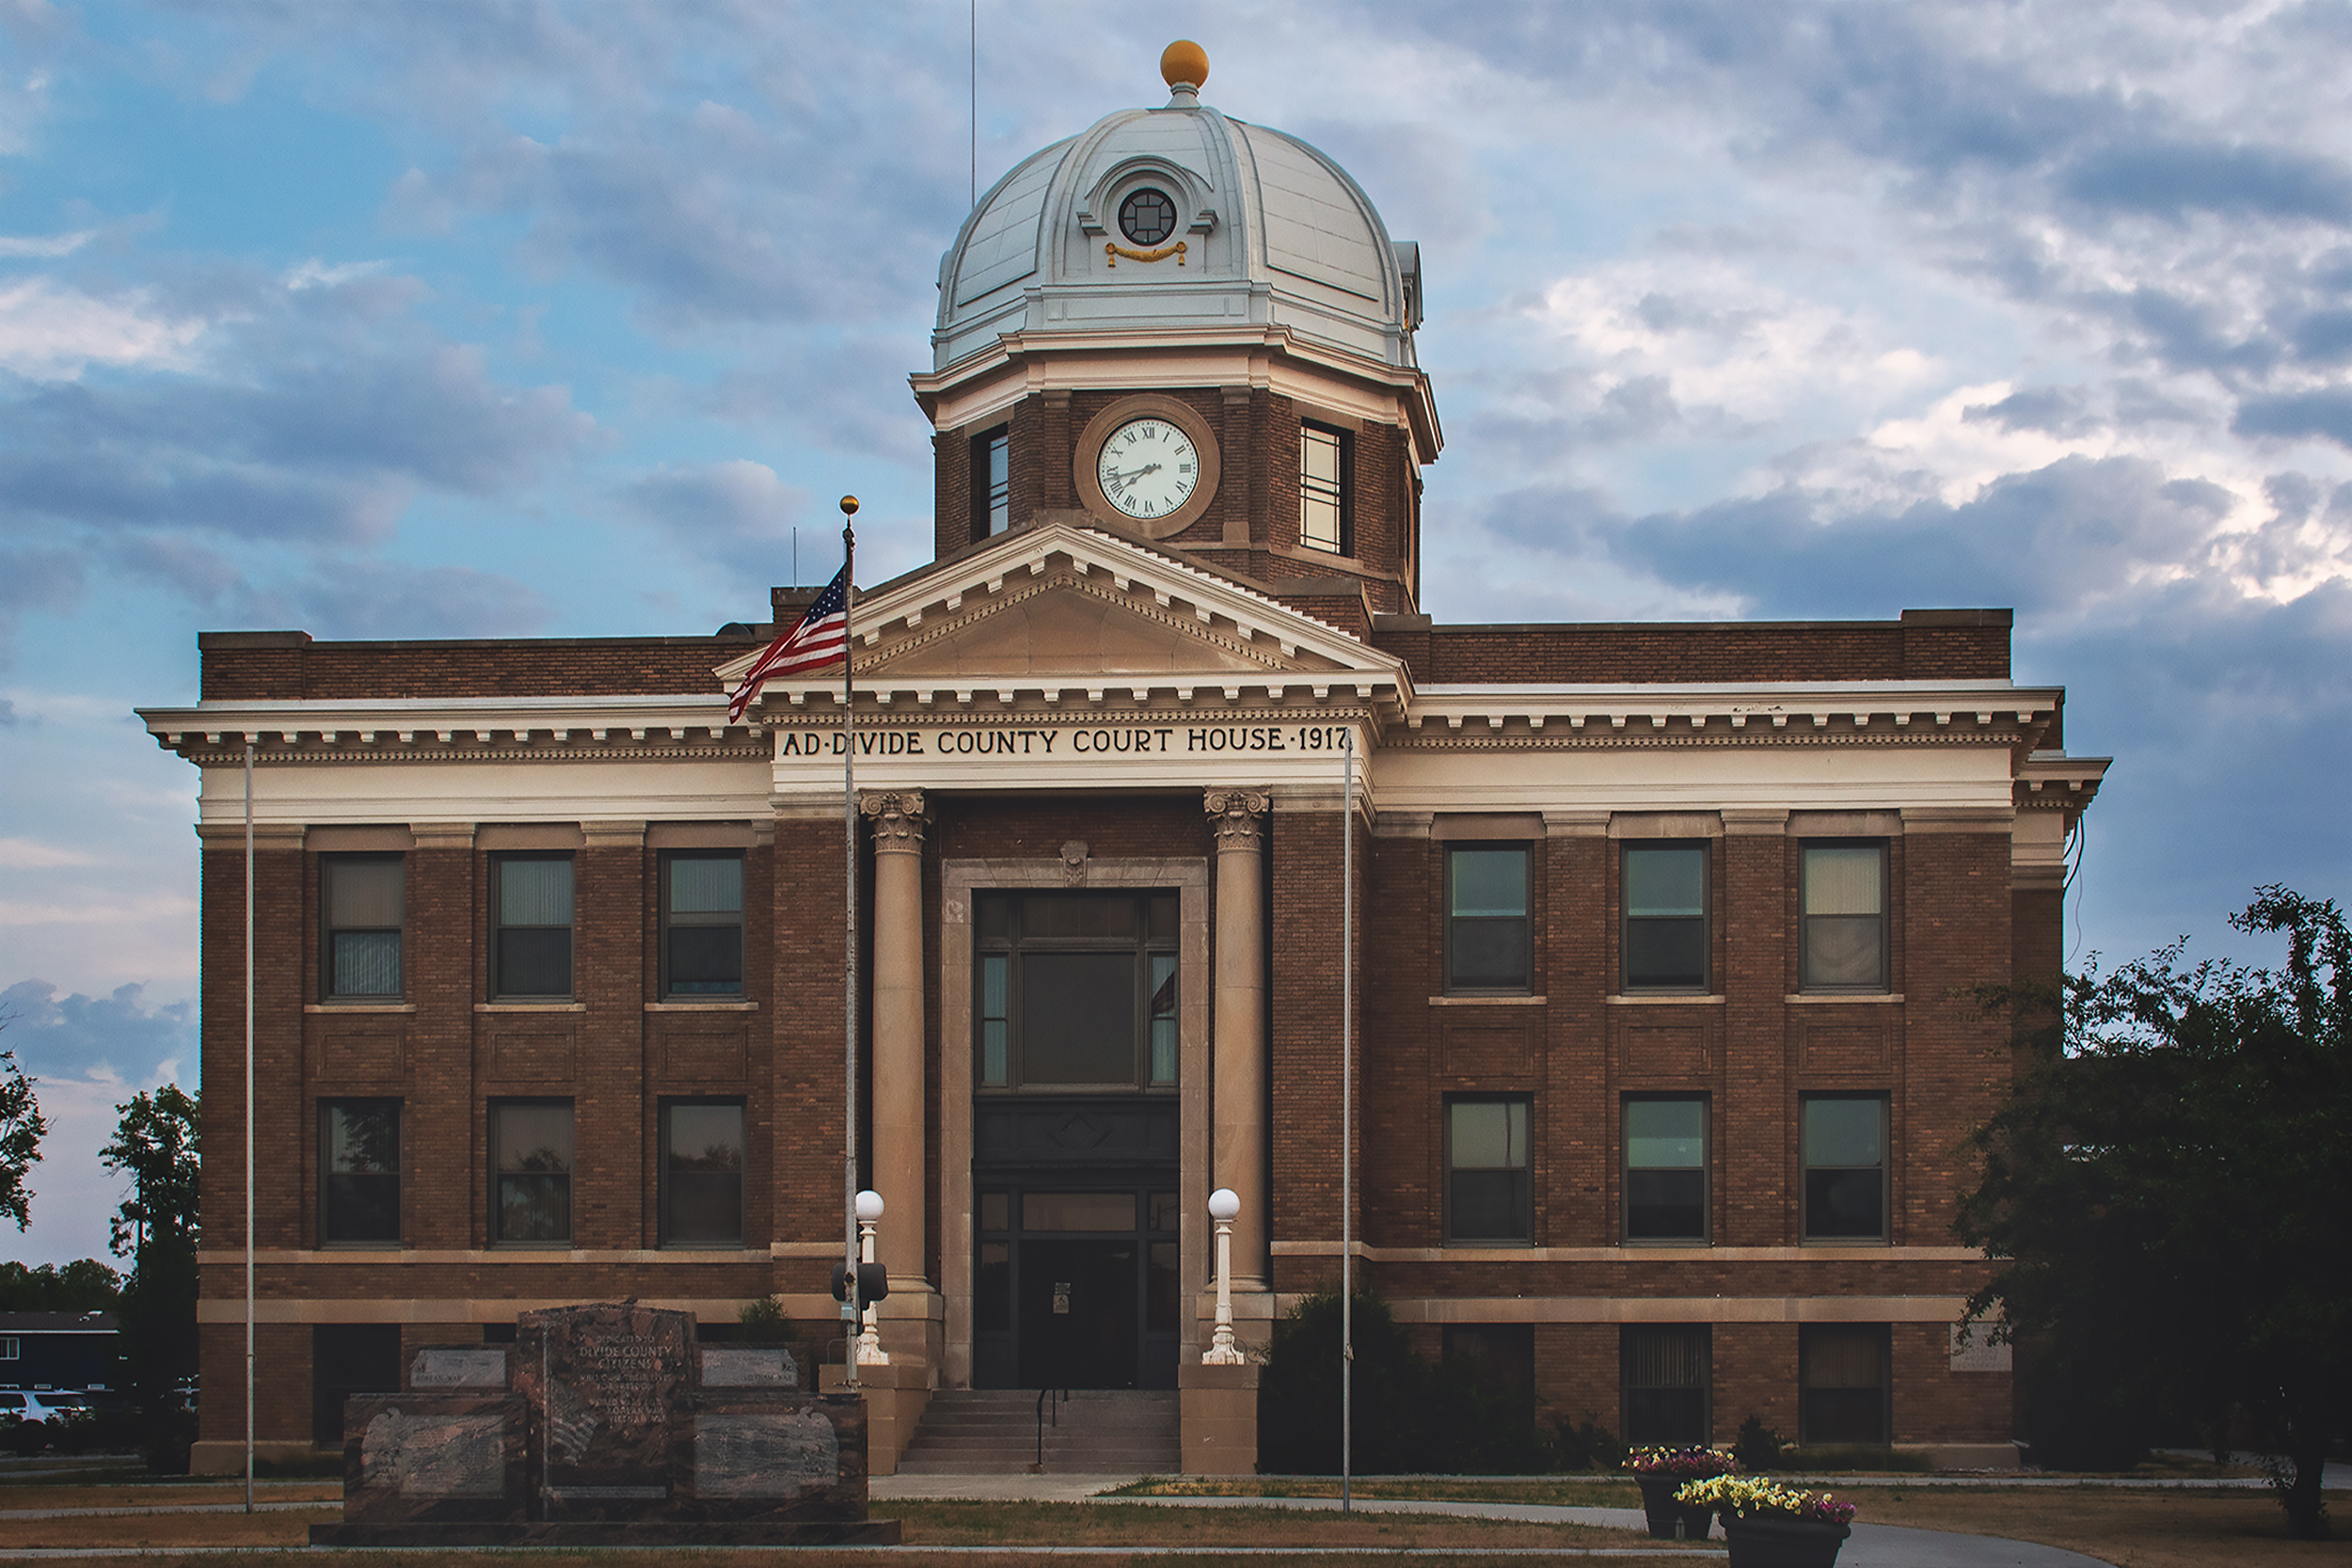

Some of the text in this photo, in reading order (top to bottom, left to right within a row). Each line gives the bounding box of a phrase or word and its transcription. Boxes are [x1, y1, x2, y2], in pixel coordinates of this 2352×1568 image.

[1141, 426, 1155, 439] XII
[1123, 431, 1137, 447] XI
[1111, 447, 1124, 458] X
[1174, 444, 1186, 456] II
[937, 730, 1058, 753] COUNTY
[1073, 729, 1174, 752] COURT
[580, 1346, 673, 1357] DIVIDE COUNTY
[597, 1358, 652, 1370] CITIZENS
